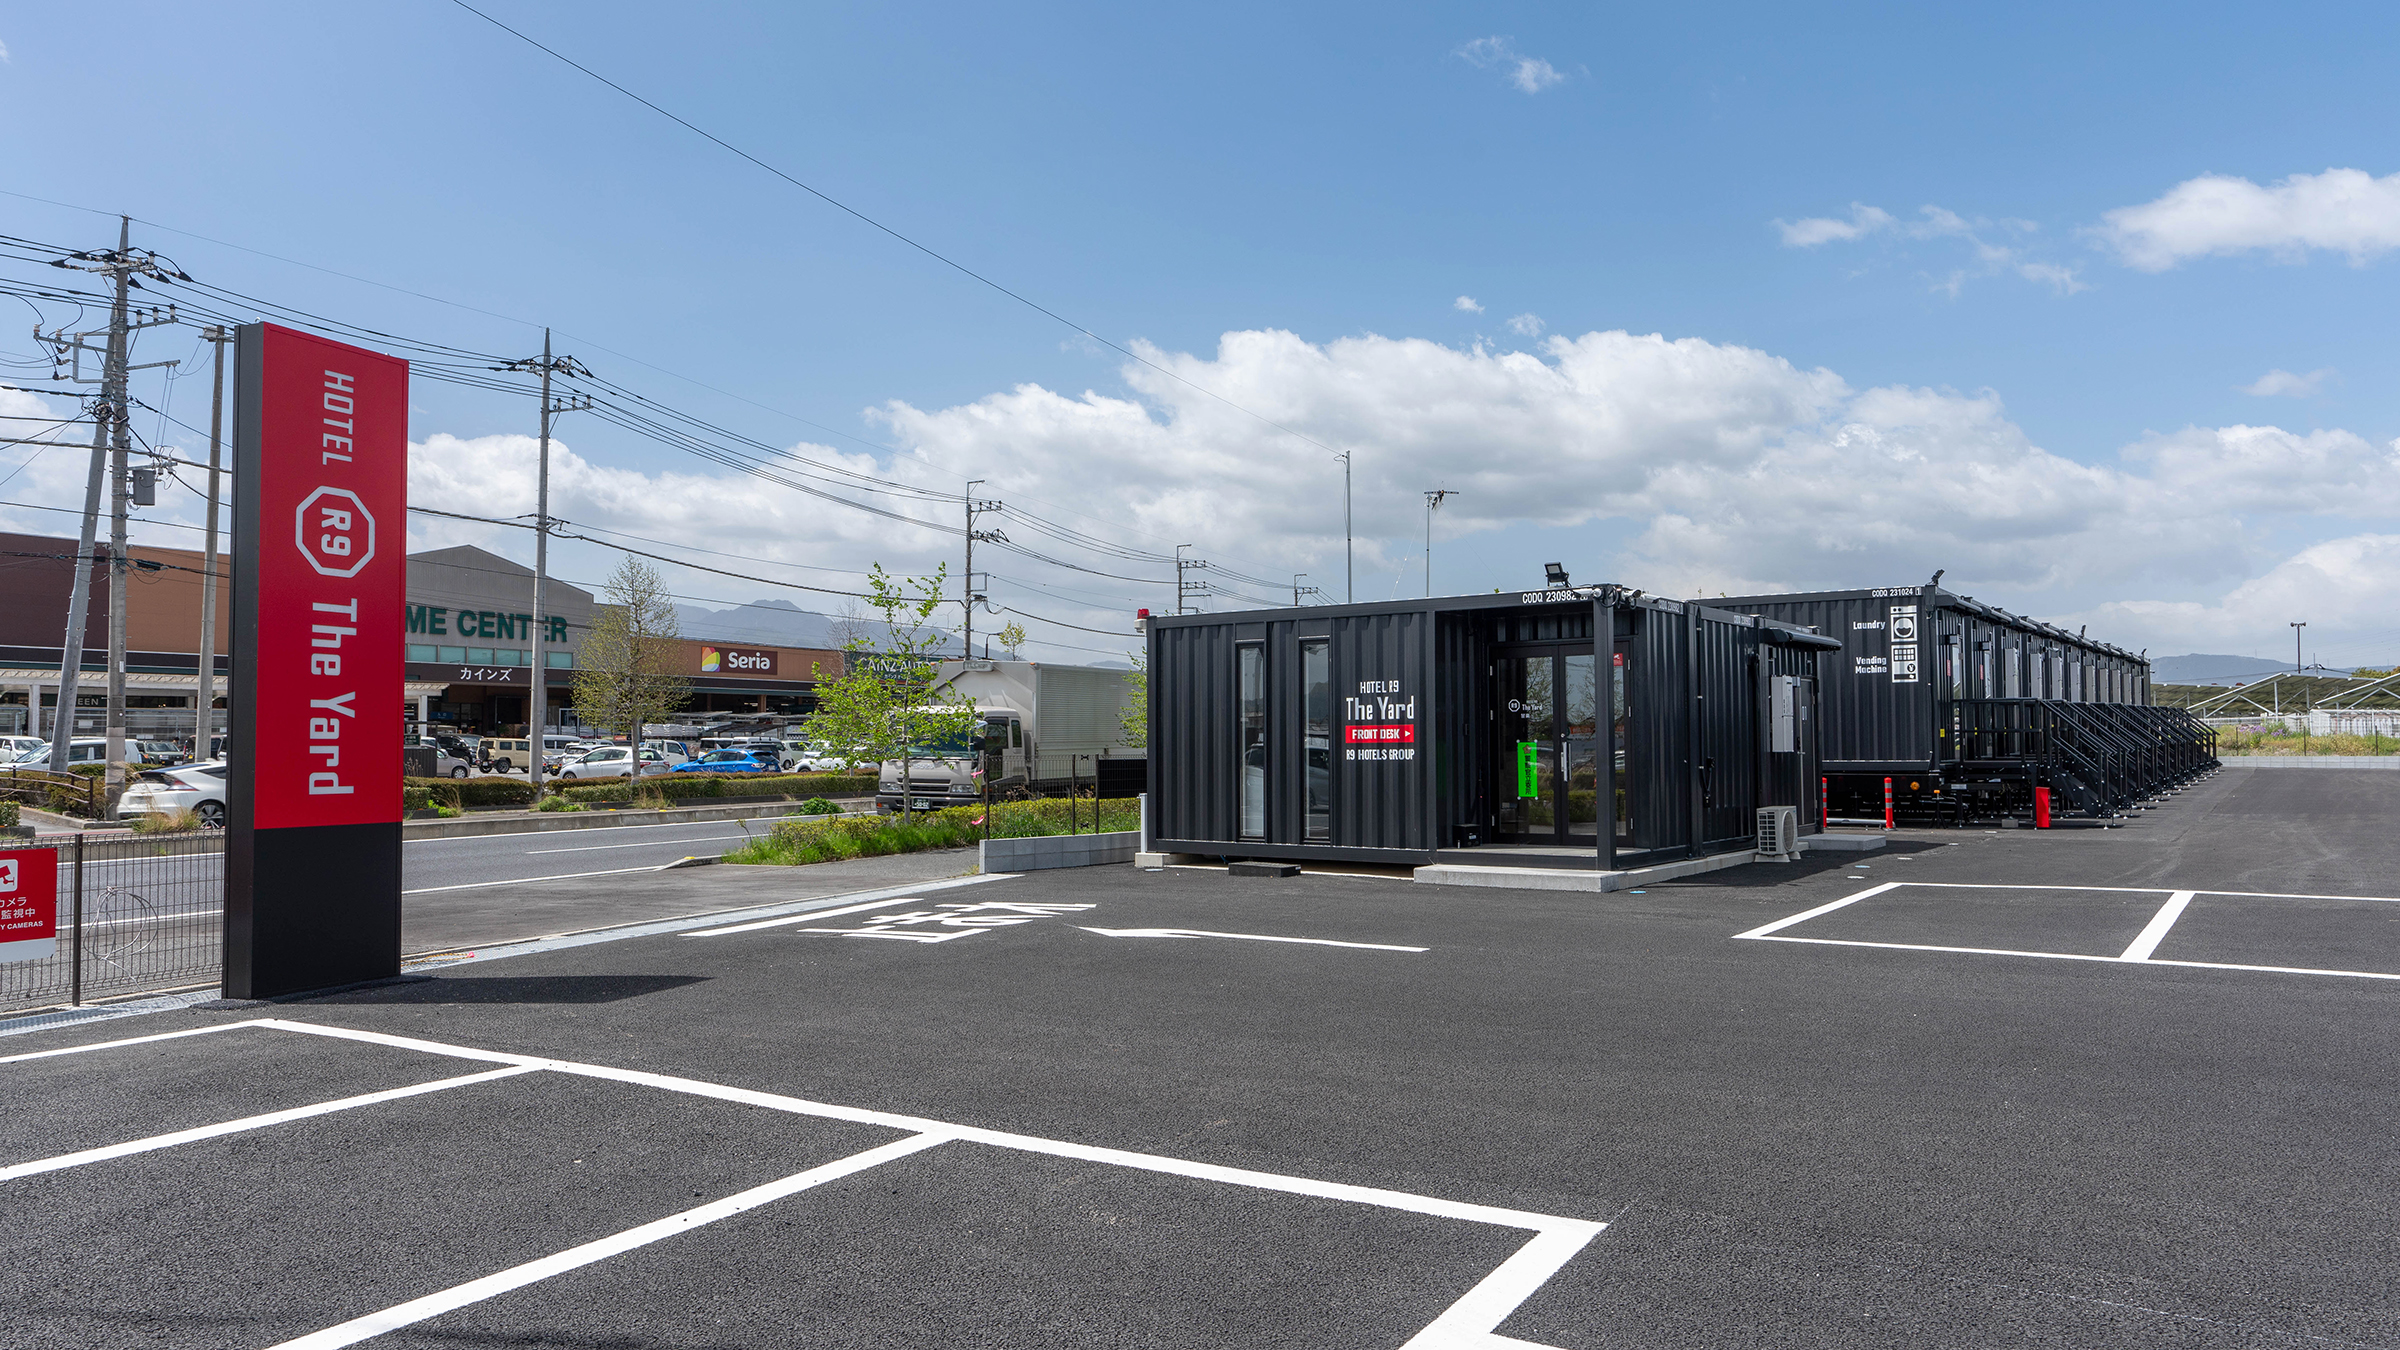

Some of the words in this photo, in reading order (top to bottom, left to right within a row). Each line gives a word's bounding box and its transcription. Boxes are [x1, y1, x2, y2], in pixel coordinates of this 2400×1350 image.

[322, 369, 354, 466] HOTEL
[320, 507, 352, 557] R9
[1522, 592, 1543, 604] CODQ
[1890, 588, 1914, 597] 231024
[1853, 620, 1886, 630] Laundry
[310, 598, 358, 676] The
[728, 651, 771, 670] Seria
[1856, 656, 1887, 665] Vending
[460, 667, 513, 681] カインズ
[1855, 665, 1888, 674] Machine
[1360, 681, 1387, 694] HOTEL
[1388, 680, 1399, 693] R9
[1346, 697, 1373, 720] The
[1377, 695, 1415, 720] Yard
[1352, 729, 1378, 740] FRONT
[1380, 728, 1400, 739] DESK
[308, 691, 356, 795] Yard
[1346, 749, 1356, 760] R9
[1358, 749, 1387, 760] HOTELS
[1388, 748, 1415, 760] GROUP
[7, 920, 44, 931] CAMERAS
